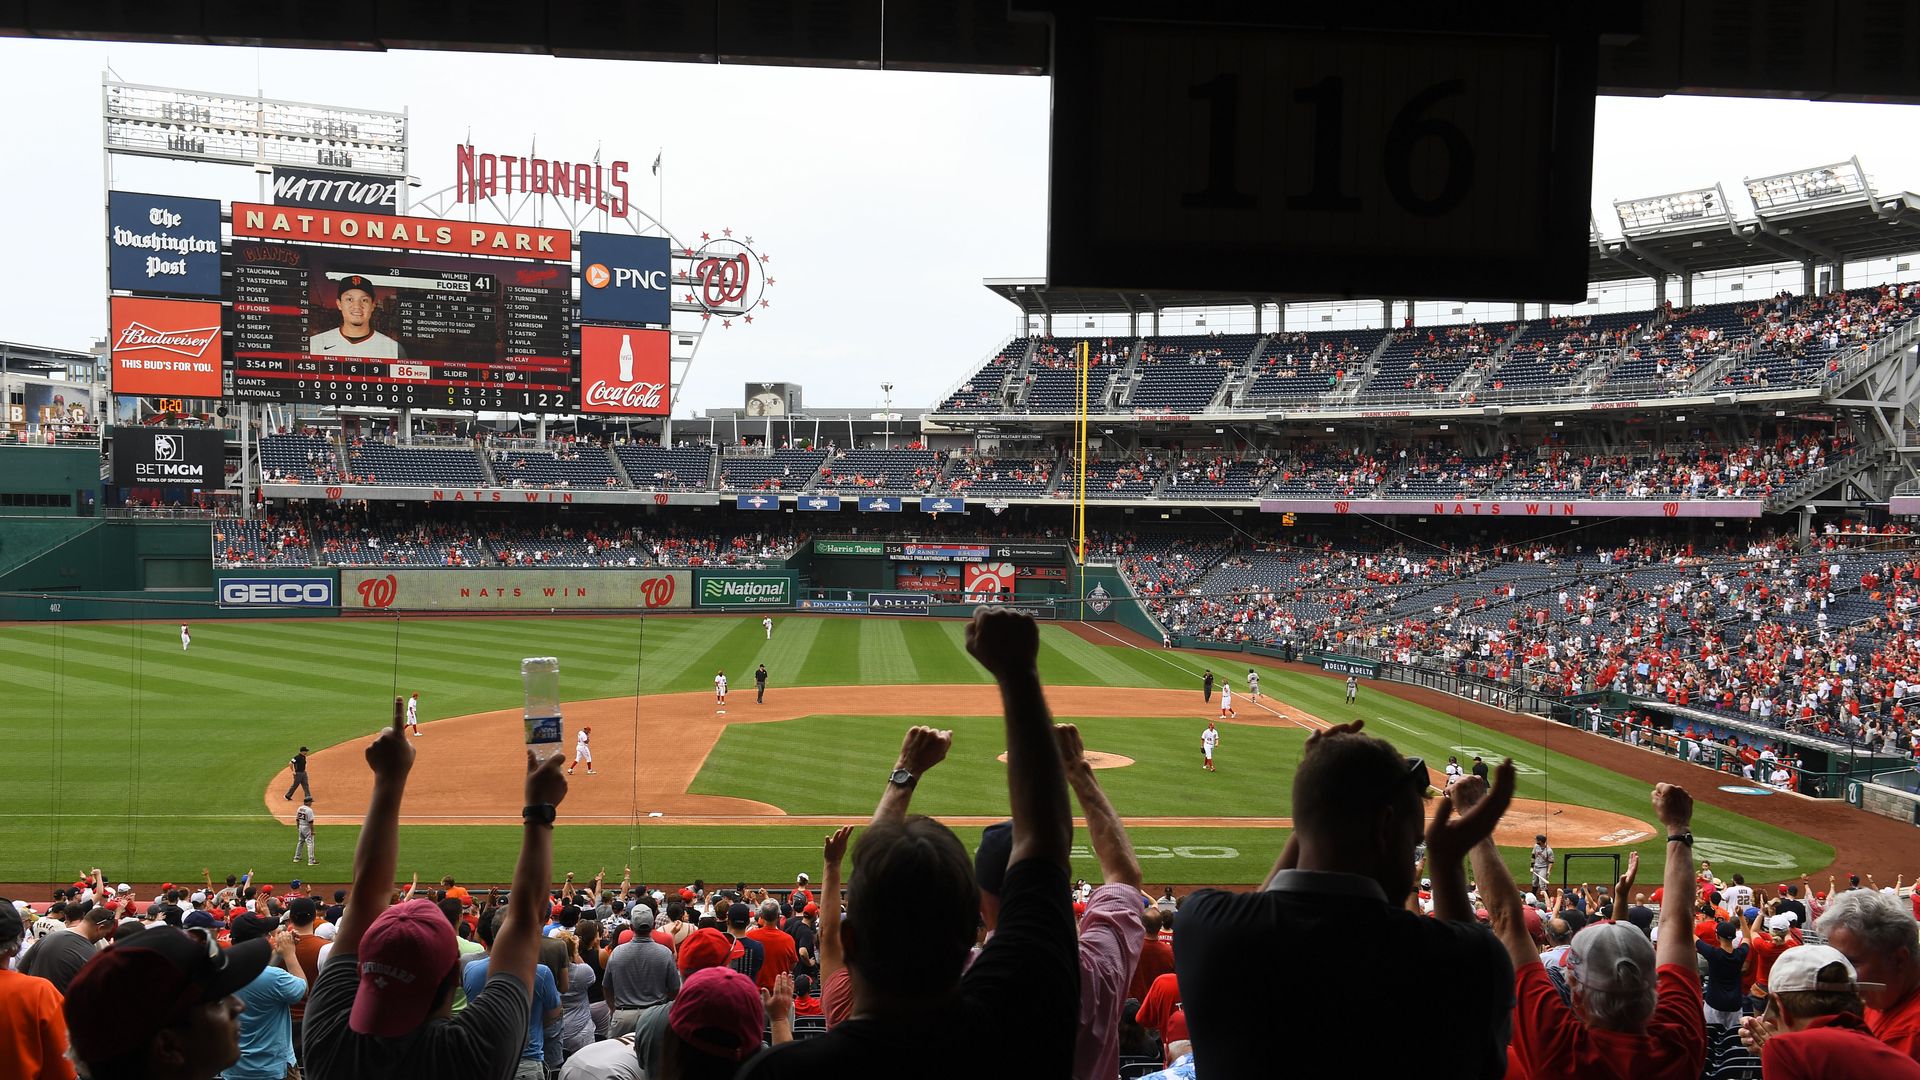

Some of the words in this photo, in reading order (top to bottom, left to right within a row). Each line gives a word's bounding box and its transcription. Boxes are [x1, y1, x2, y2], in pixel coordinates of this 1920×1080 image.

[1182, 73, 1475, 217] 116
[456, 144, 628, 218] NATIONALS
[274, 176, 398, 206] NATITUDE
[150, 208, 181, 228] The
[246, 210, 452, 244] NATIONALS
[471, 230, 554, 252] PARK
[114, 226, 218, 256] Washington
[244, 244, 300, 266] GIANTS
[146, 256, 187, 277] Post
[475, 277, 490, 290] 41
[613, 268, 666, 290] PNC
[437, 282, 468, 290] FLORES
[122, 328, 210, 346] Budweiser
[121, 359, 142, 368] THIS
[144, 360, 172, 370] BUD'S
[174, 362, 191, 371] FOR
[193, 363, 214, 372] YOU.
[246, 360, 266, 368] 3:54
[398, 367, 412, 376] 86
[524, 393, 529, 405] 1
[539, 394, 547, 406] 2
[555, 394, 564, 407] 2
[586, 380, 665, 408] Coca-Cola
[160, 399, 182, 411] 0:20
[136, 463, 203, 476] BETMGM
[434, 491, 500, 501] NATS
[525, 493, 572, 503] WIN
[1434, 504, 1500, 515] NATS
[1526, 504, 1575, 515] WIN
[997, 548, 1010, 557] rts
[223, 584, 329, 603] GEICO
[461, 588, 521, 597] NATS
[543, 588, 586, 597] WIN
[723, 582, 784, 596] National
[50, 604, 61, 612] 402
[885, 600, 926, 609] DELTA
[1330, 663, 1347, 672] DELTA
[1355, 666, 1373, 676] DELTA
[298, 812, 306, 820] 23
[1737, 895, 1750, 905] 22
